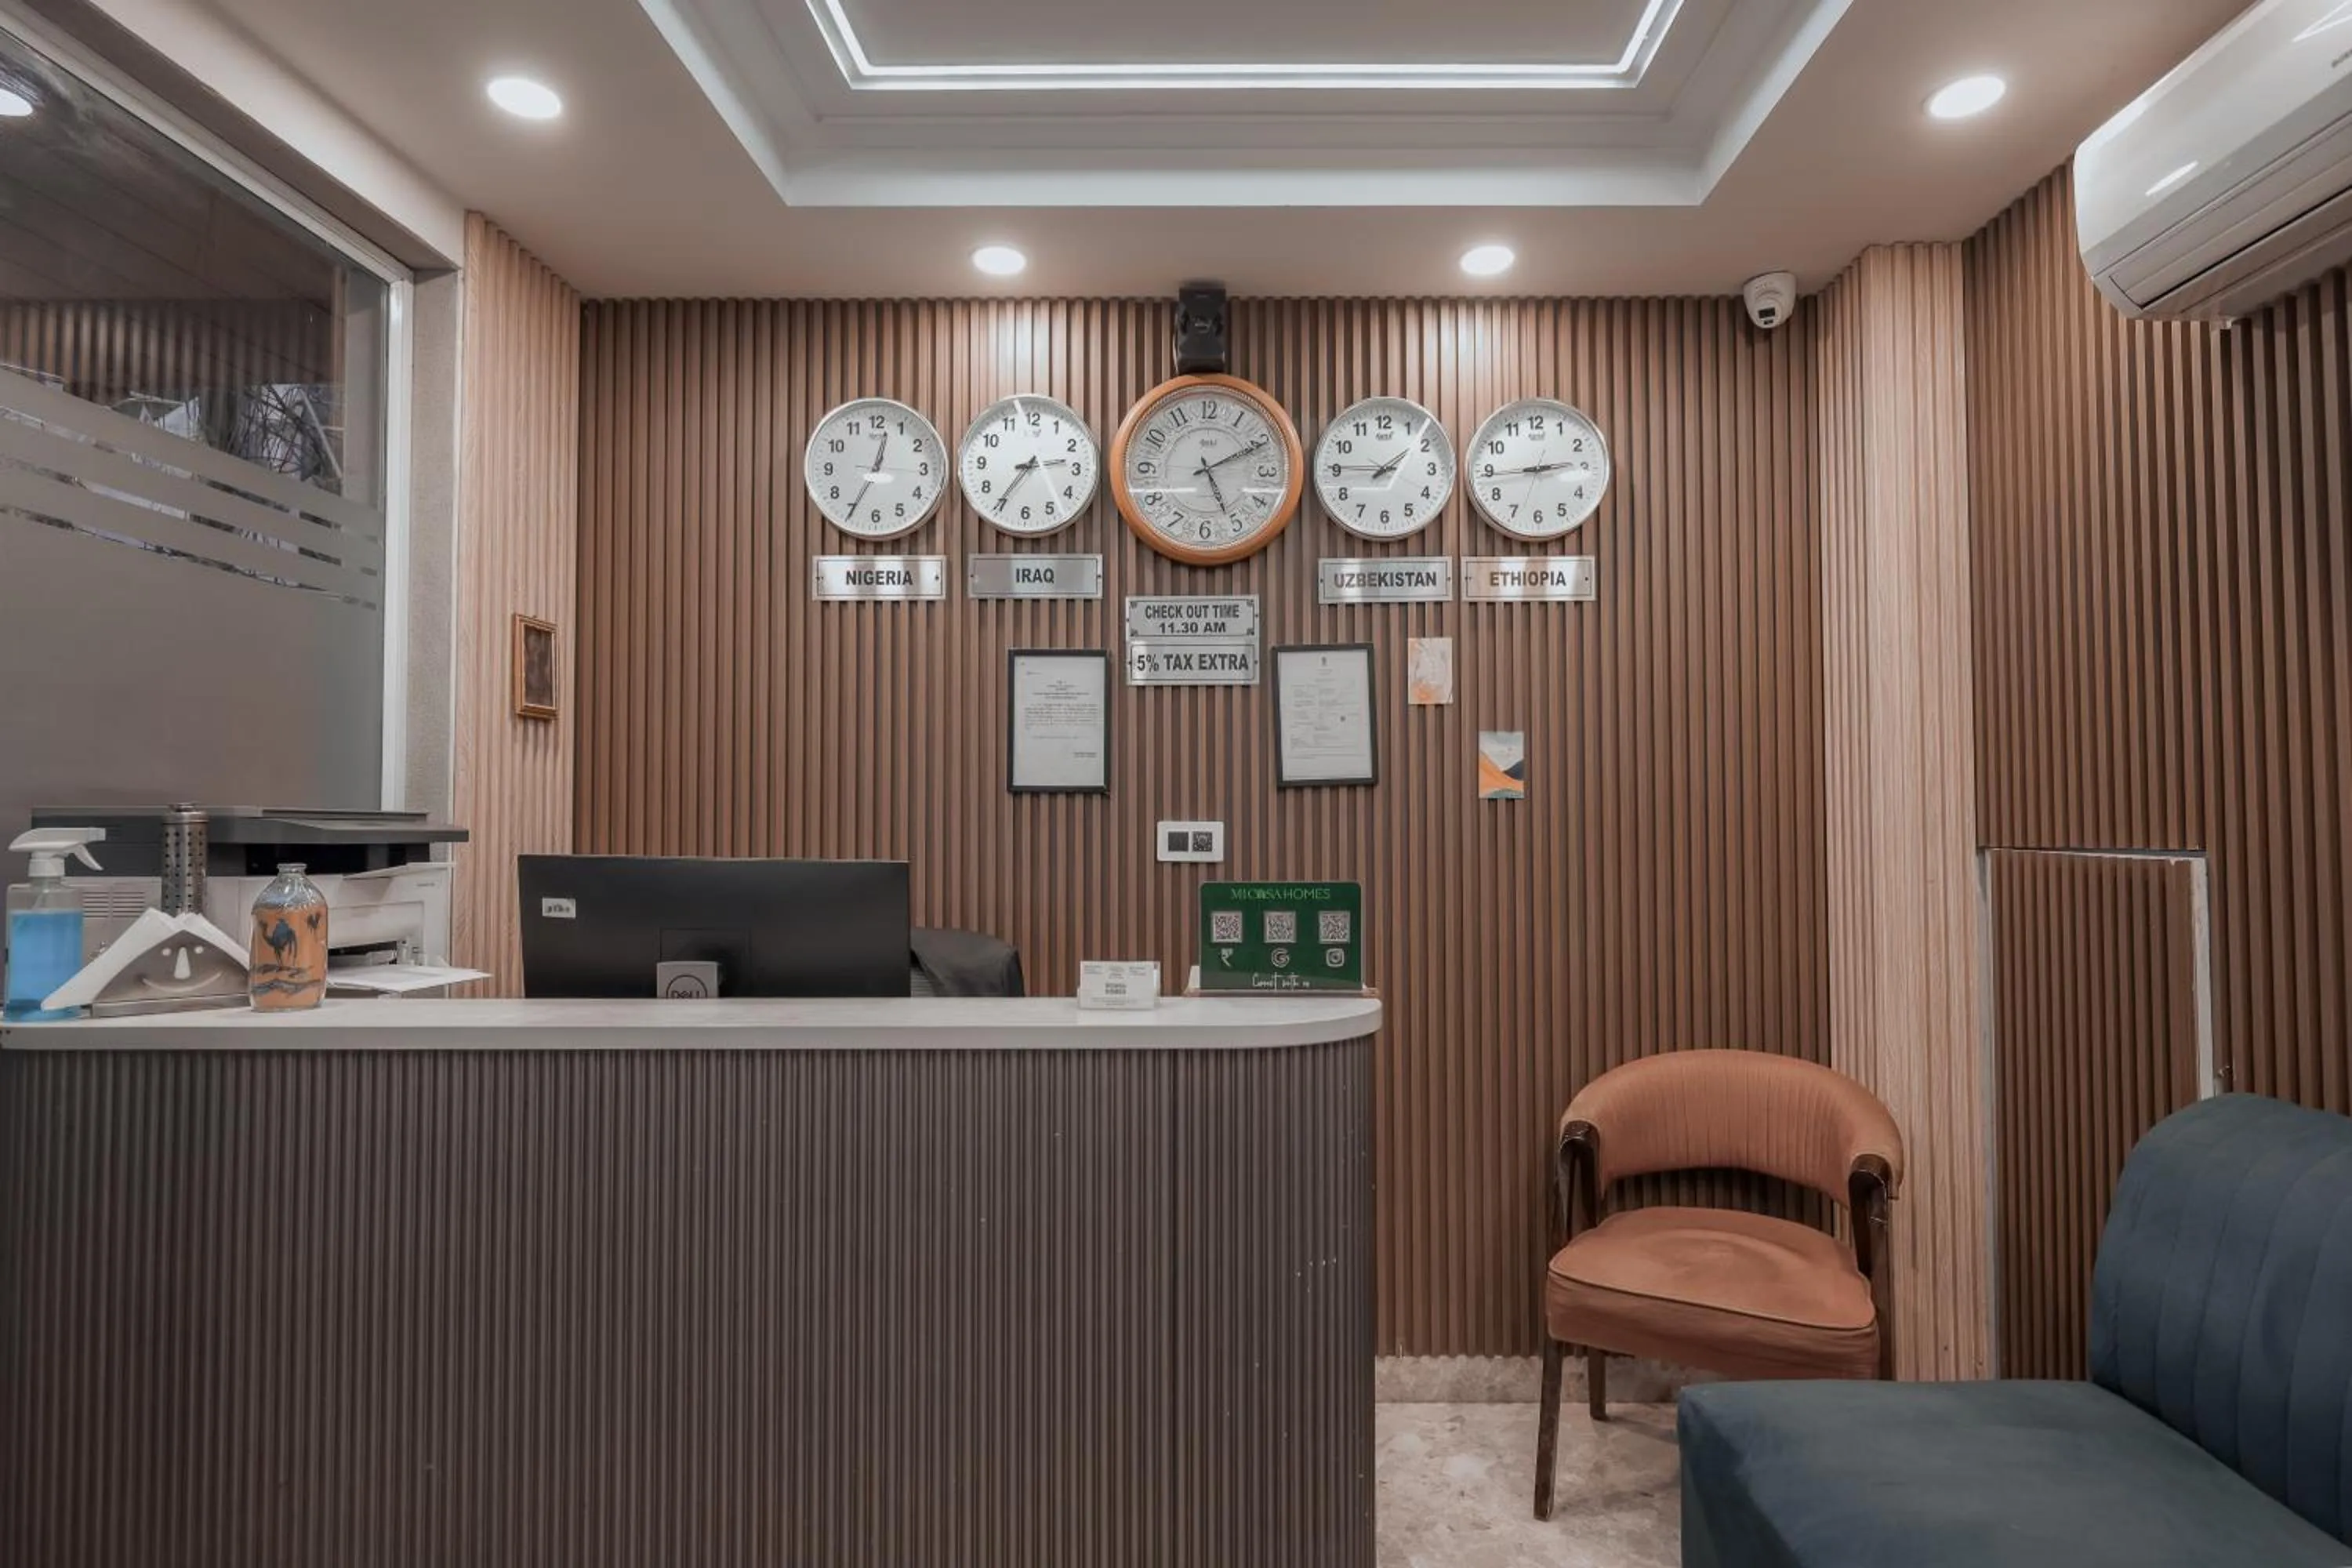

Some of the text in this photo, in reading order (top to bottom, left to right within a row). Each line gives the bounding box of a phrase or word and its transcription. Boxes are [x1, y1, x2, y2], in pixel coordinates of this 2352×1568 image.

[1200, 401, 1218, 419] 12
[869, 415, 885, 429] 12
[1003, 417, 1015, 431] 11
[1026, 412, 1040, 426] 12
[1170, 408, 1188, 427] 11
[1232, 411, 1245, 427] 1
[1374, 415, 1392, 430] 12
[1527, 415, 1544, 430] 12
[847, 422, 860, 435] 11
[897, 422, 904, 435] 1
[1054, 420, 1059, 434] 1
[1353, 422, 1367, 436] 11
[1405, 422, 1411, 435] 1
[1505, 423, 1519, 436] 11
[1556, 422, 1563, 435] 1
[828, 440, 844, 452] 10
[913, 439, 923, 452] 2
[983, 434, 1000, 448] 10
[1067, 438, 1076, 452] 2
[1146, 429, 1167, 449] 10
[1421, 438, 1431, 452] 2
[1573, 438, 1583, 452] 2
[1335, 440, 1352, 454] 10
[1488, 441, 1504, 455] 10
[824, 463, 833, 476] 9
[919, 463, 928, 476] 3
[977, 456, 986, 470] 9
[1072, 462, 1081, 476] 3
[1138, 461, 1156, 474] 9
[1332, 463, 1341, 477] 9
[1427, 462, 1437, 475] 3
[1484, 463, 1494, 477] 9
[1258, 465, 1277, 477] 3
[830, 486, 840, 499] 8
[912, 486, 922, 499] 4
[982, 480, 991, 493] 8
[1063, 485, 1073, 499] 4
[1421, 485, 1430, 499] 4
[1573, 485, 1584, 499] 4
[1144, 491, 1163, 506] 8
[1338, 487, 1348, 501] 8
[1492, 487, 1501, 501] 8
[1045, 501, 1054, 515] 5
[1252, 495, 1268, 509] 4
[871, 510, 880, 523] 6
[895, 503, 905, 517] 5
[1021, 506, 1030, 520] 6
[1356, 504, 1366, 518] 7
[1380, 510, 1390, 524] 6
[1404, 503, 1414, 517] 5
[1508, 504, 1519, 518] 7
[1533, 510, 1543, 524] 6
[1557, 503, 1567, 517] 5
[1167, 511, 1184, 528] 7
[1229, 513, 1243, 533] 5
[1199, 521, 1211, 539] 6
[845, 569, 913, 586] NIGERIA
[1015, 568, 1054, 583] IRAQ
[1334, 571, 1437, 588] UZBEKISTAN
[1490, 571, 1566, 587] ETHIOPIA
[1145, 604, 1240, 619] CHECK OUT TIME
[1159, 622, 1226, 633] 11.30 AM
[1137, 653, 1249, 672] 5% TAX EXTRA
[1283, 887, 1330, 900] HOMES
